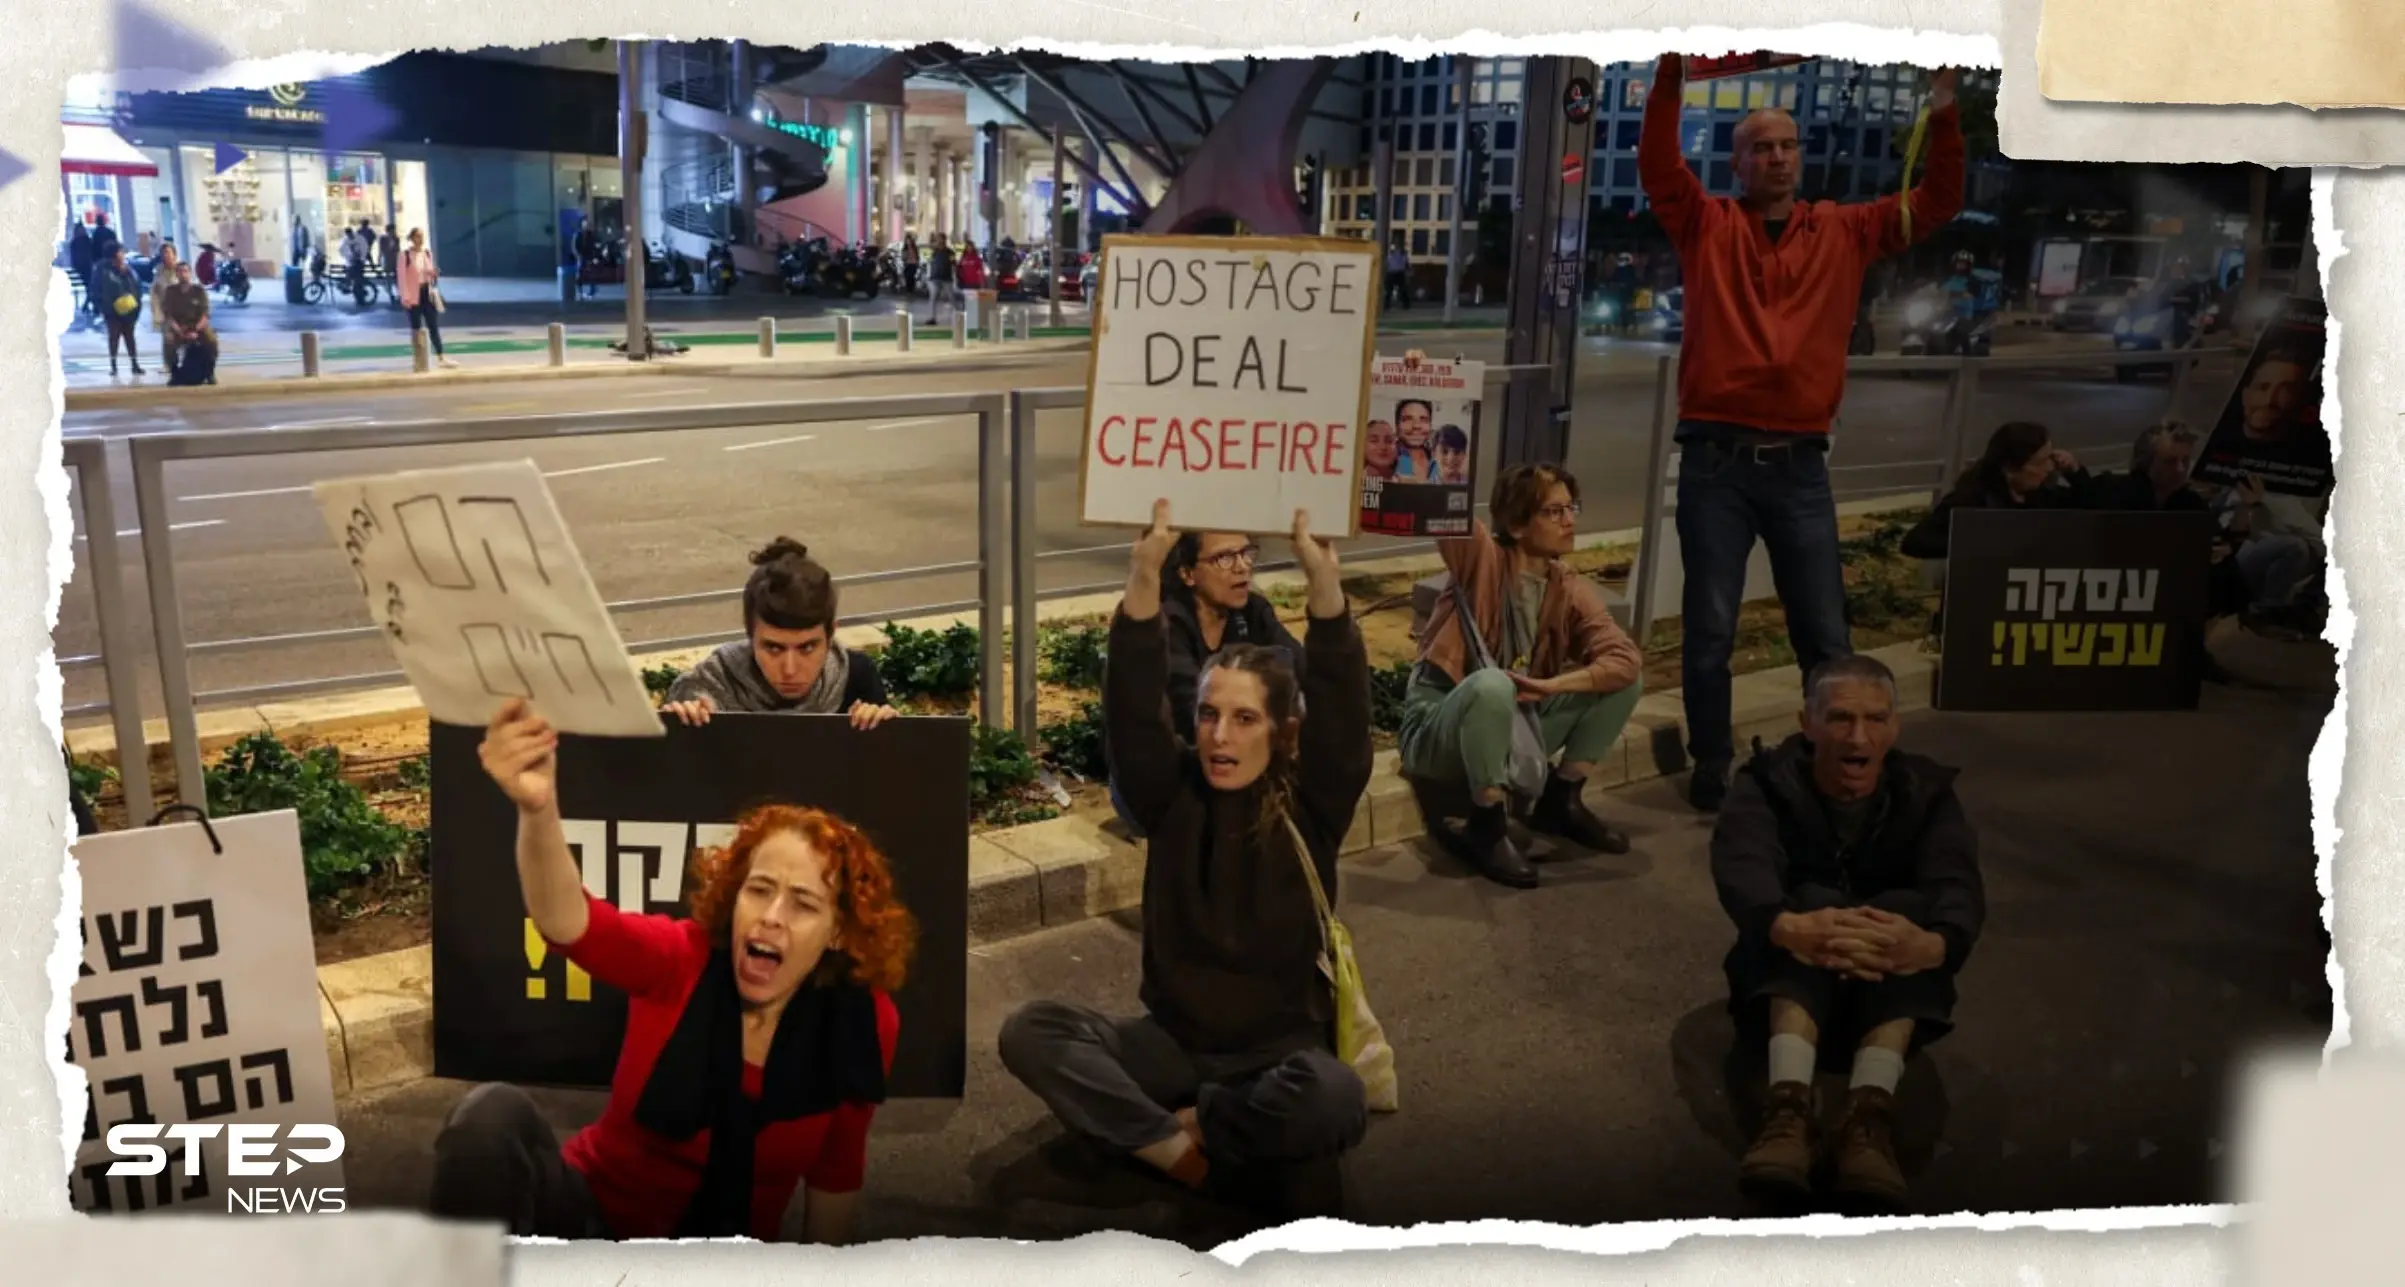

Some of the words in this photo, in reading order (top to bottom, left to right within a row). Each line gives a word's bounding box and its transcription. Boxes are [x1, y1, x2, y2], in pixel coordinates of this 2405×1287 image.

[1113, 254, 1357, 316] HOSTAGE
[1145, 331, 1309, 394] DEAL
[1096, 414, 1348, 476] CEASEFIRE
[2005, 568, 2161, 620] עסקה
[1990, 621, 2166, 668] עכשיו!
[64, 975, 229, 1063] נלח
[174, 1047, 295, 1121] הם
